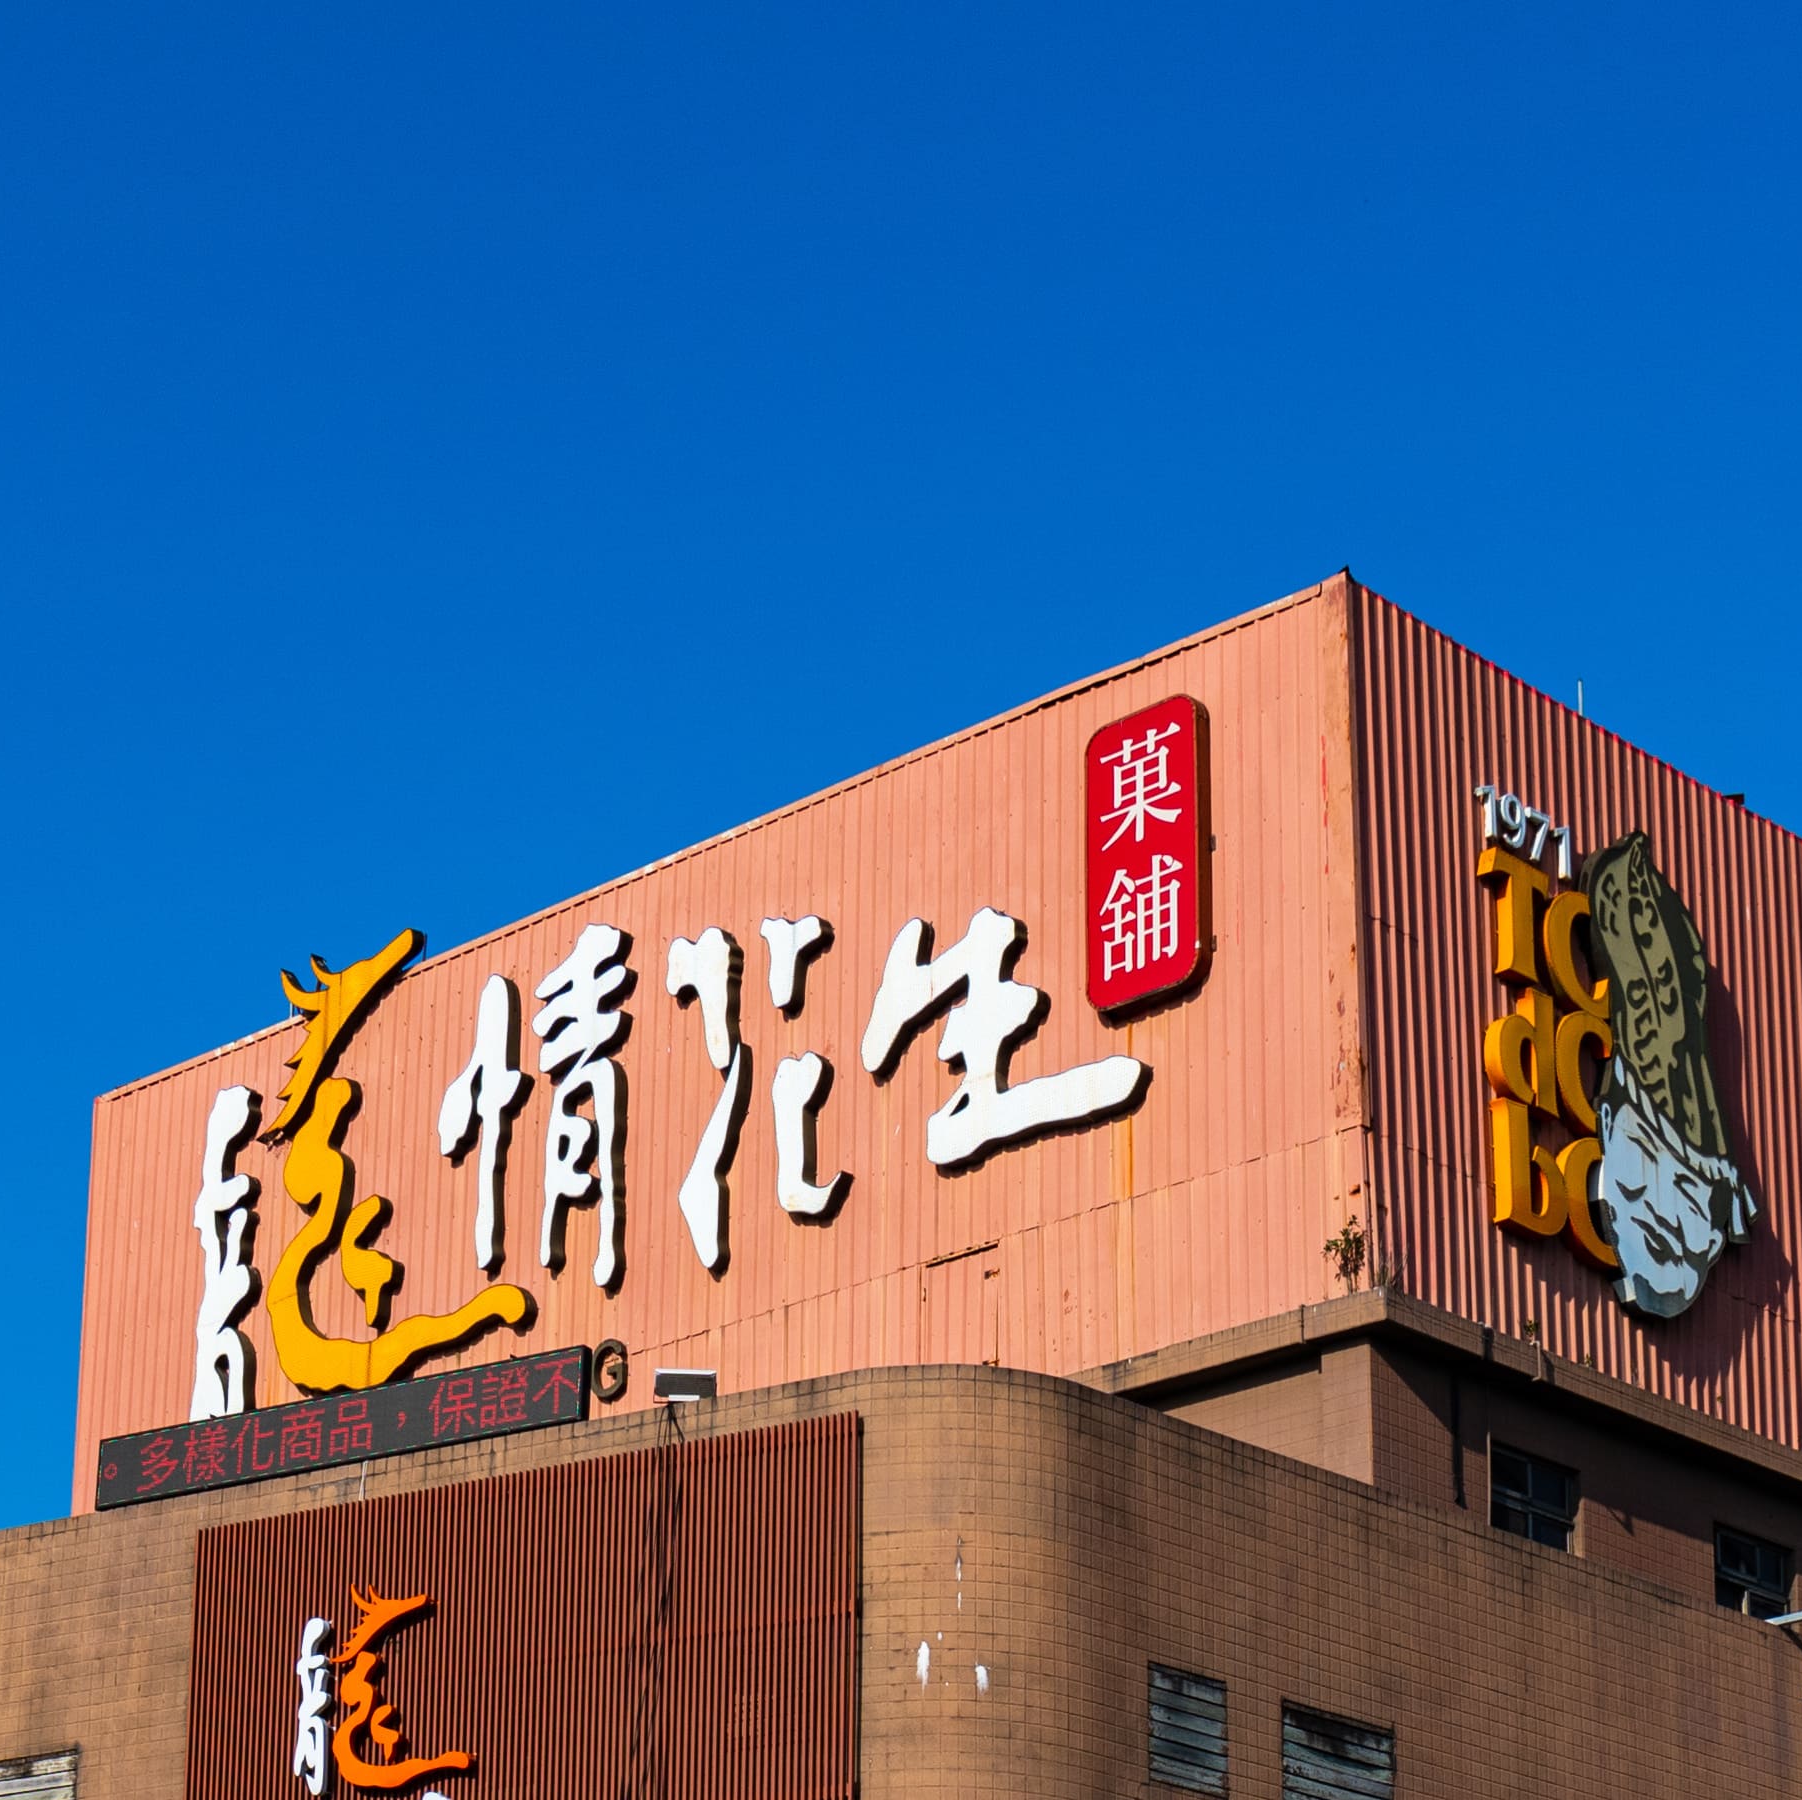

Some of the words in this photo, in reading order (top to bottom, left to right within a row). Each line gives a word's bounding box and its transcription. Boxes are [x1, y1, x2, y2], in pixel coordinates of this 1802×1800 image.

[1099, 722, 1183, 982] 菓舖
[1473, 785, 1572, 880] 1971
[193, 908, 1154, 1420] 龍情花生
